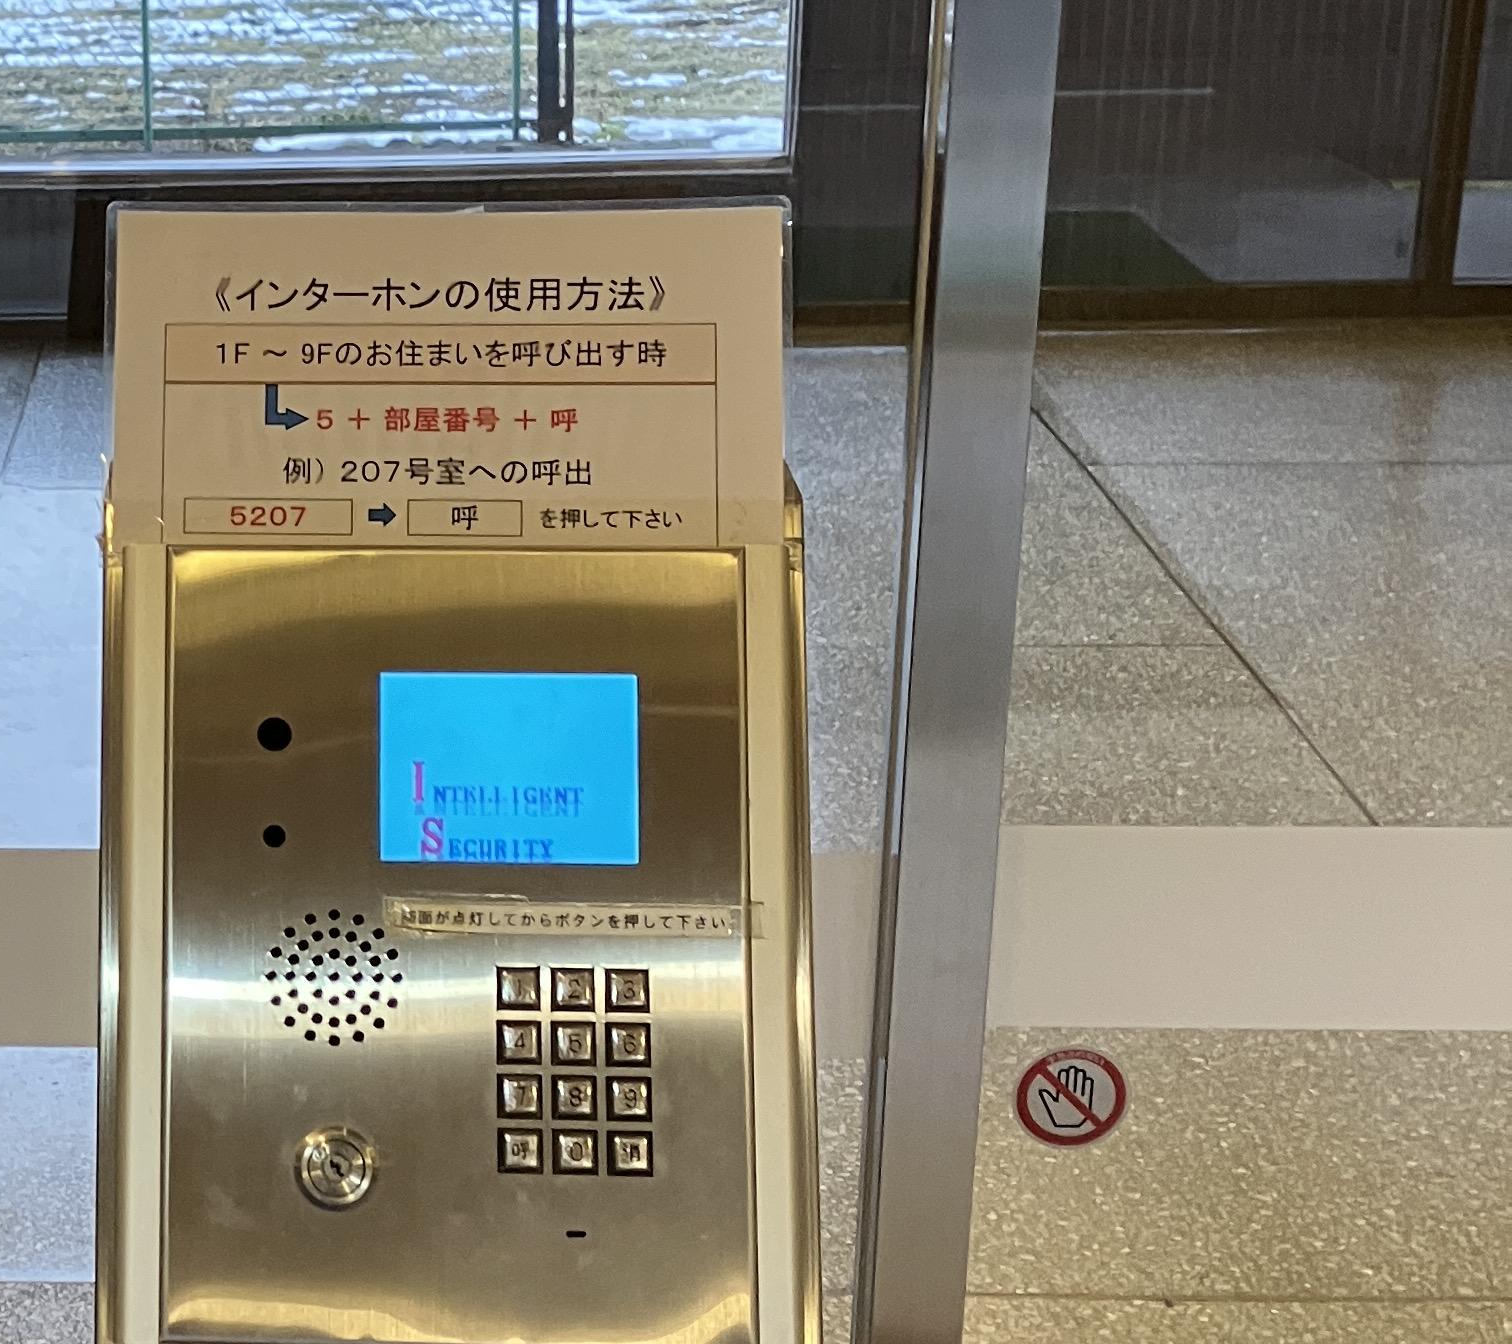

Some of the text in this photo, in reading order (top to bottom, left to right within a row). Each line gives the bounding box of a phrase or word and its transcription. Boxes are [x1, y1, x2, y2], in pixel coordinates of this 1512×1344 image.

[384, 406, 497, 433] 部屋番号
[550, 406, 578, 433] 呼
[230, 504, 682, 530] 5207 呼 を押して下さい
[568, 978, 581, 999] 2
[514, 1032, 525, 1049] 4
[623, 1033, 636, 1054] 6
[568, 1086, 582, 1107] 8
[624, 1087, 638, 1109] 9
